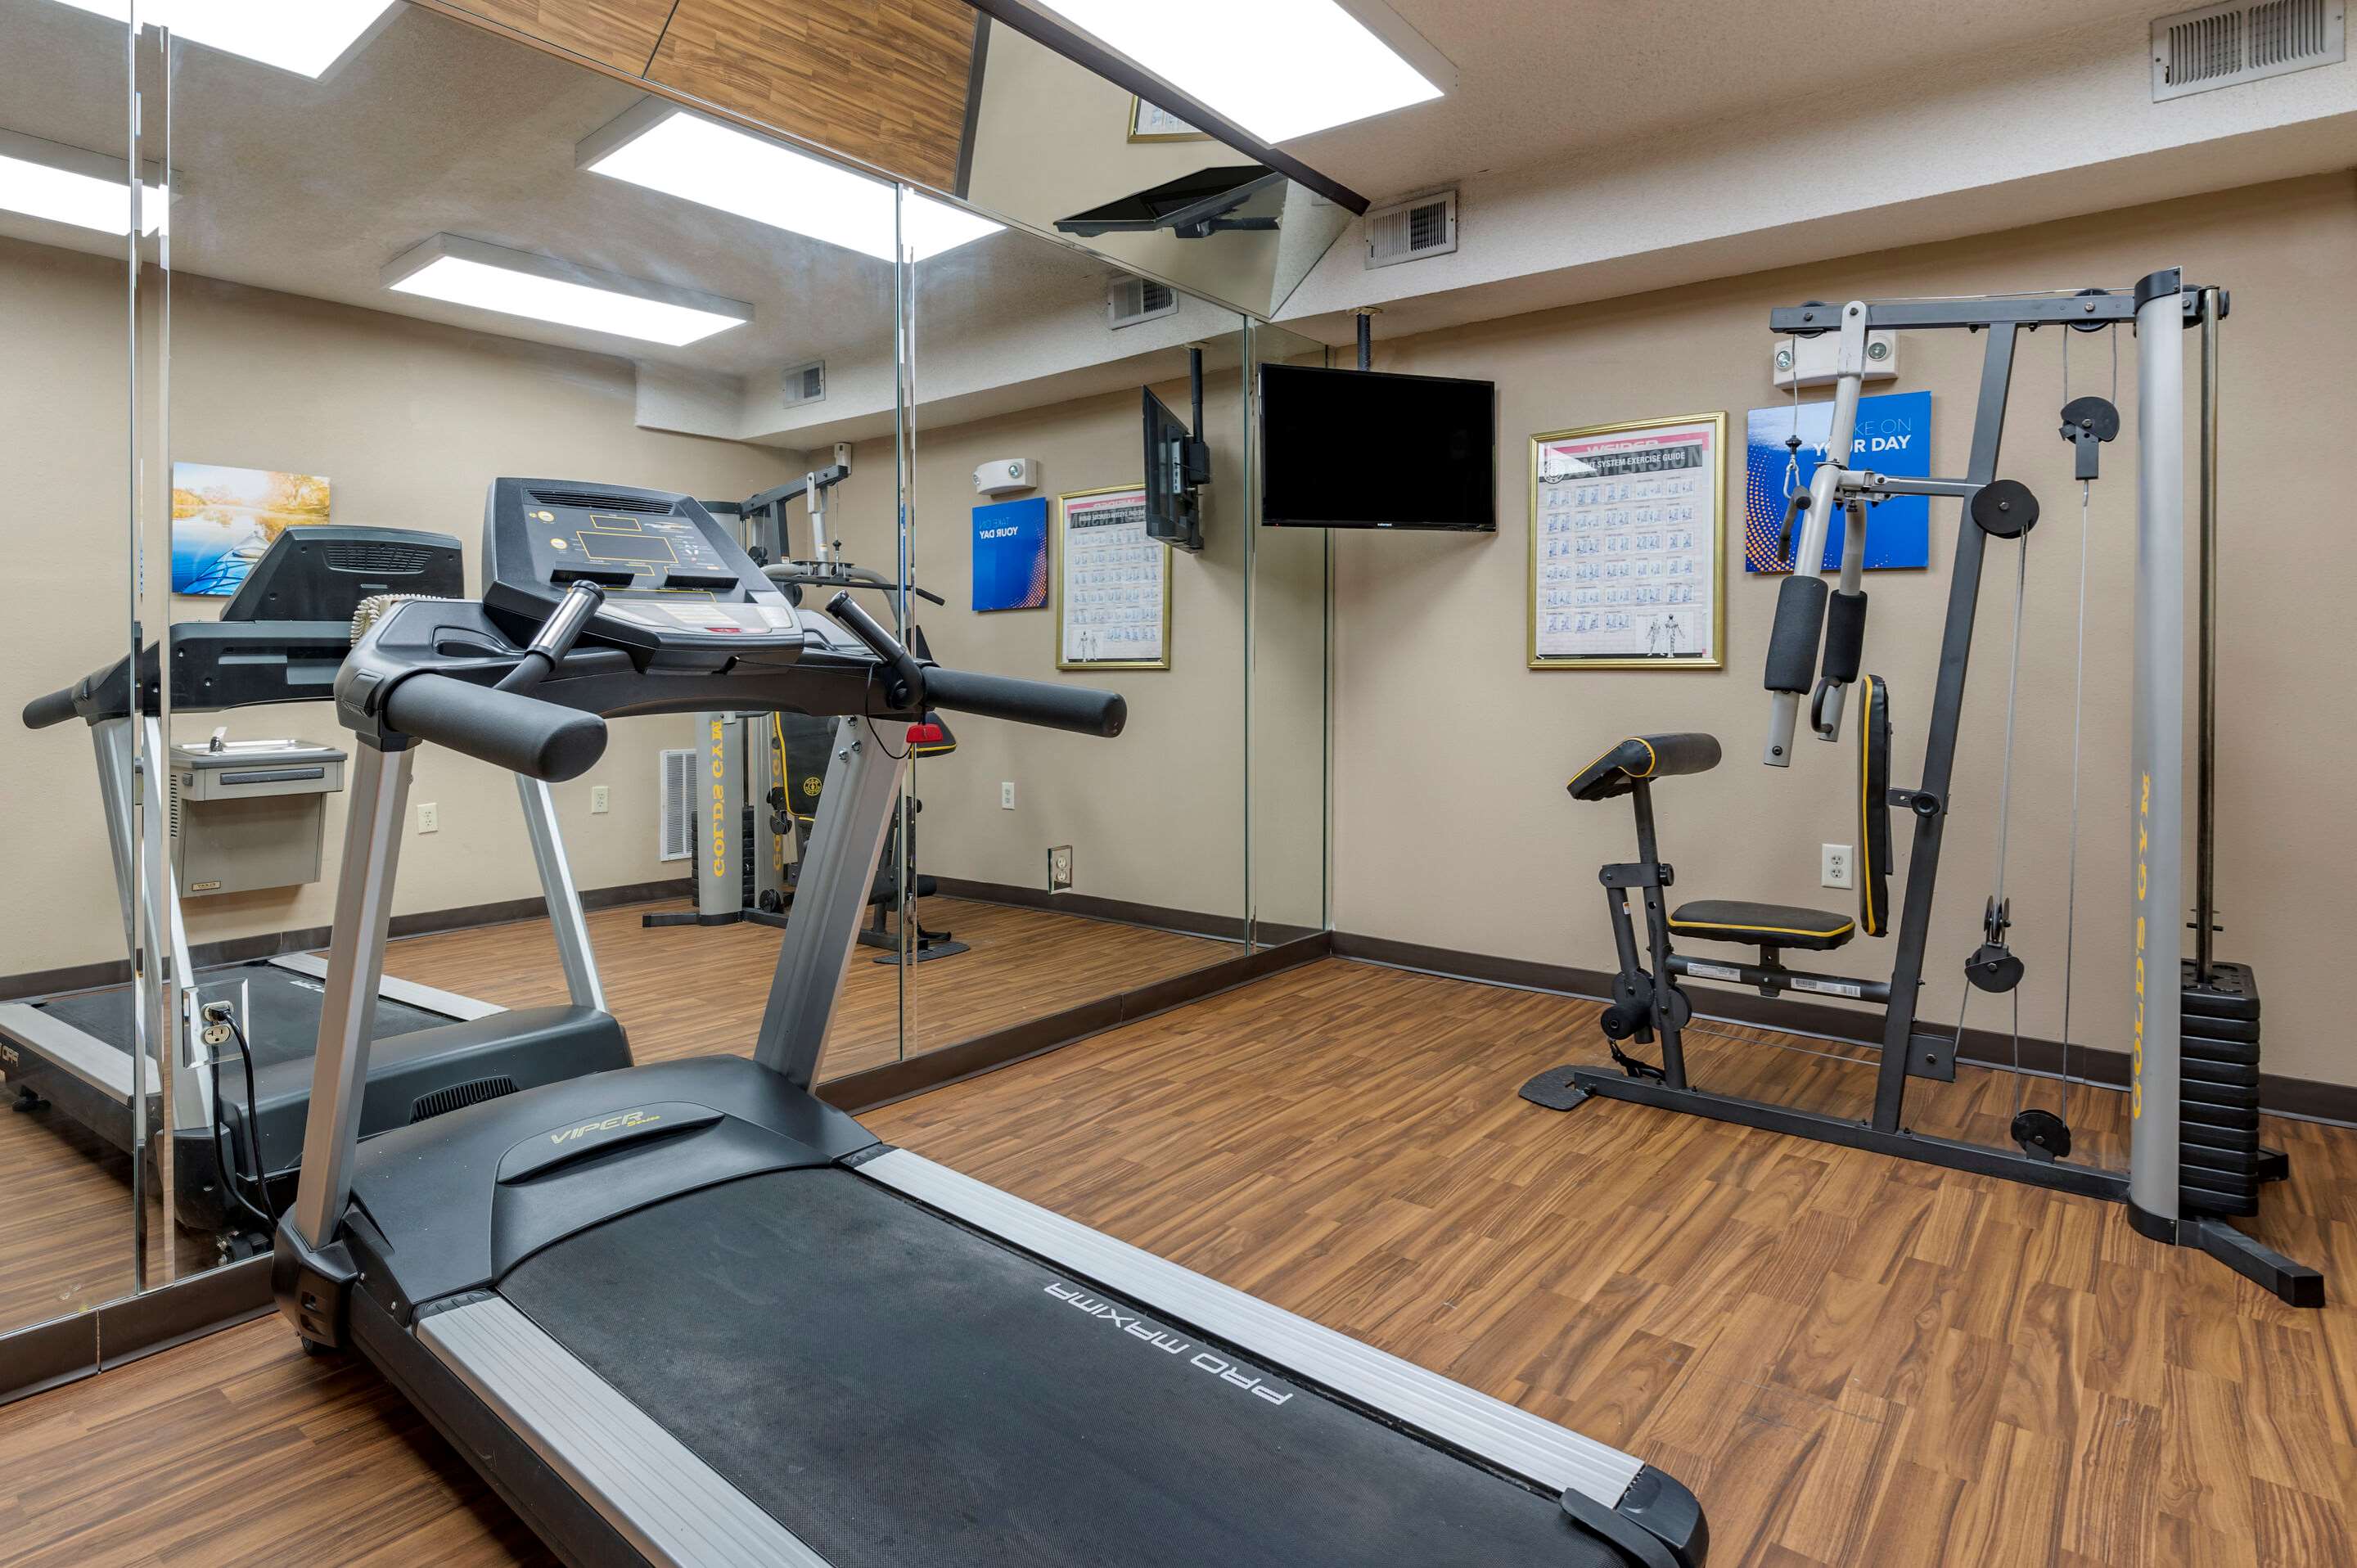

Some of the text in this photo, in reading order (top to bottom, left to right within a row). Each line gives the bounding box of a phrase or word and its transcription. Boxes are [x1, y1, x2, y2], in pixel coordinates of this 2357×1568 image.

[1854, 417, 1911, 436] KE ON
[1597, 458, 1626, 468] SYSTEM
[1627, 454, 1661, 466] EXERCISE
[1662, 451, 1686, 462] GUIDE
[1813, 435, 1912, 457] YR DAY
[2133, 770, 2152, 1120] GOLD'S GYM
[551, 1111, 644, 1144] VIPER
[1043, 1282, 1293, 1405] PRO MAXIMA
